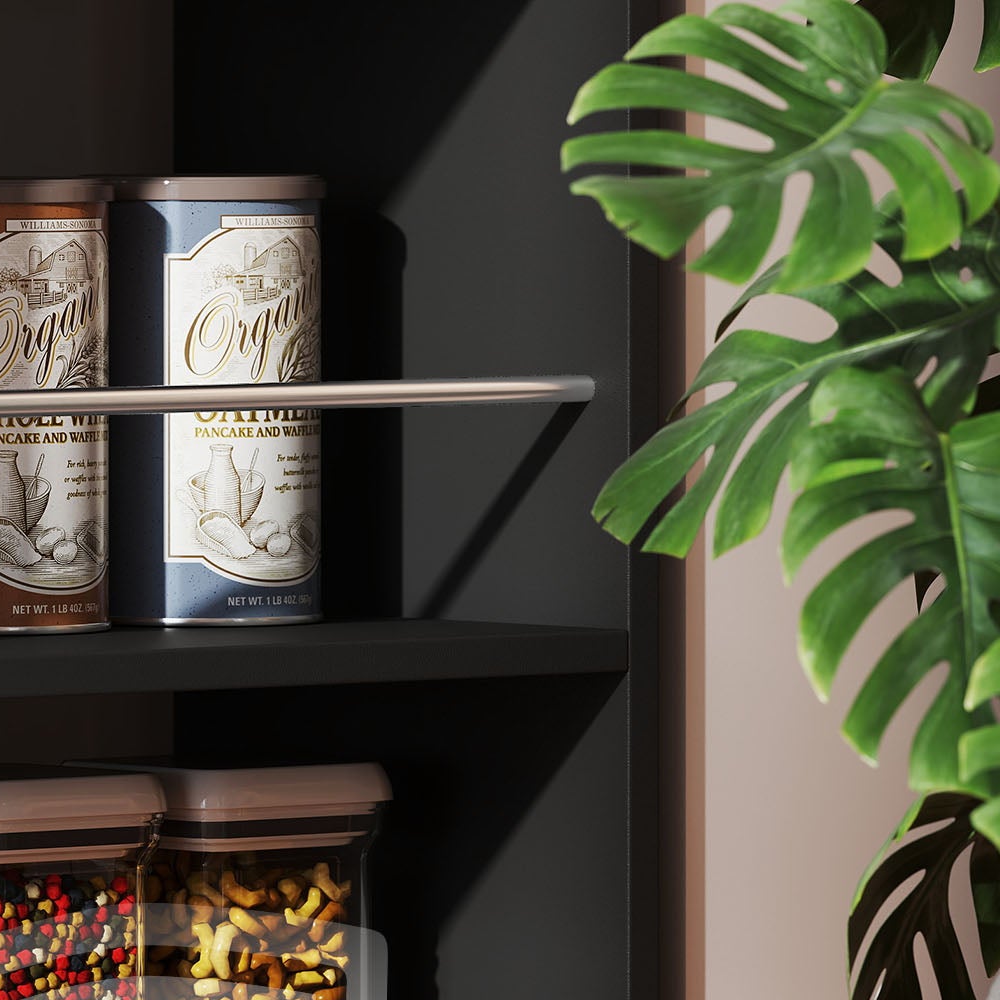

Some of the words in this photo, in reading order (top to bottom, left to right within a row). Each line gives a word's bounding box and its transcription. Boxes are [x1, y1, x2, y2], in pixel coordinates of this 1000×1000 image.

[20, 220, 96, 229] WILLIAMS-SONOMA
[195, 427, 254, 438] PANCAKE
[256, 426, 280, 437] AND
[42, 432, 67, 444] AND
[227, 596, 246, 606] NET
[248, 596, 264, 605] WT.
[272, 596, 282, 605] LB
[12, 605, 31, 614] NET
[33, 605, 49, 614] WT.
[58, 604, 68, 613] LB
